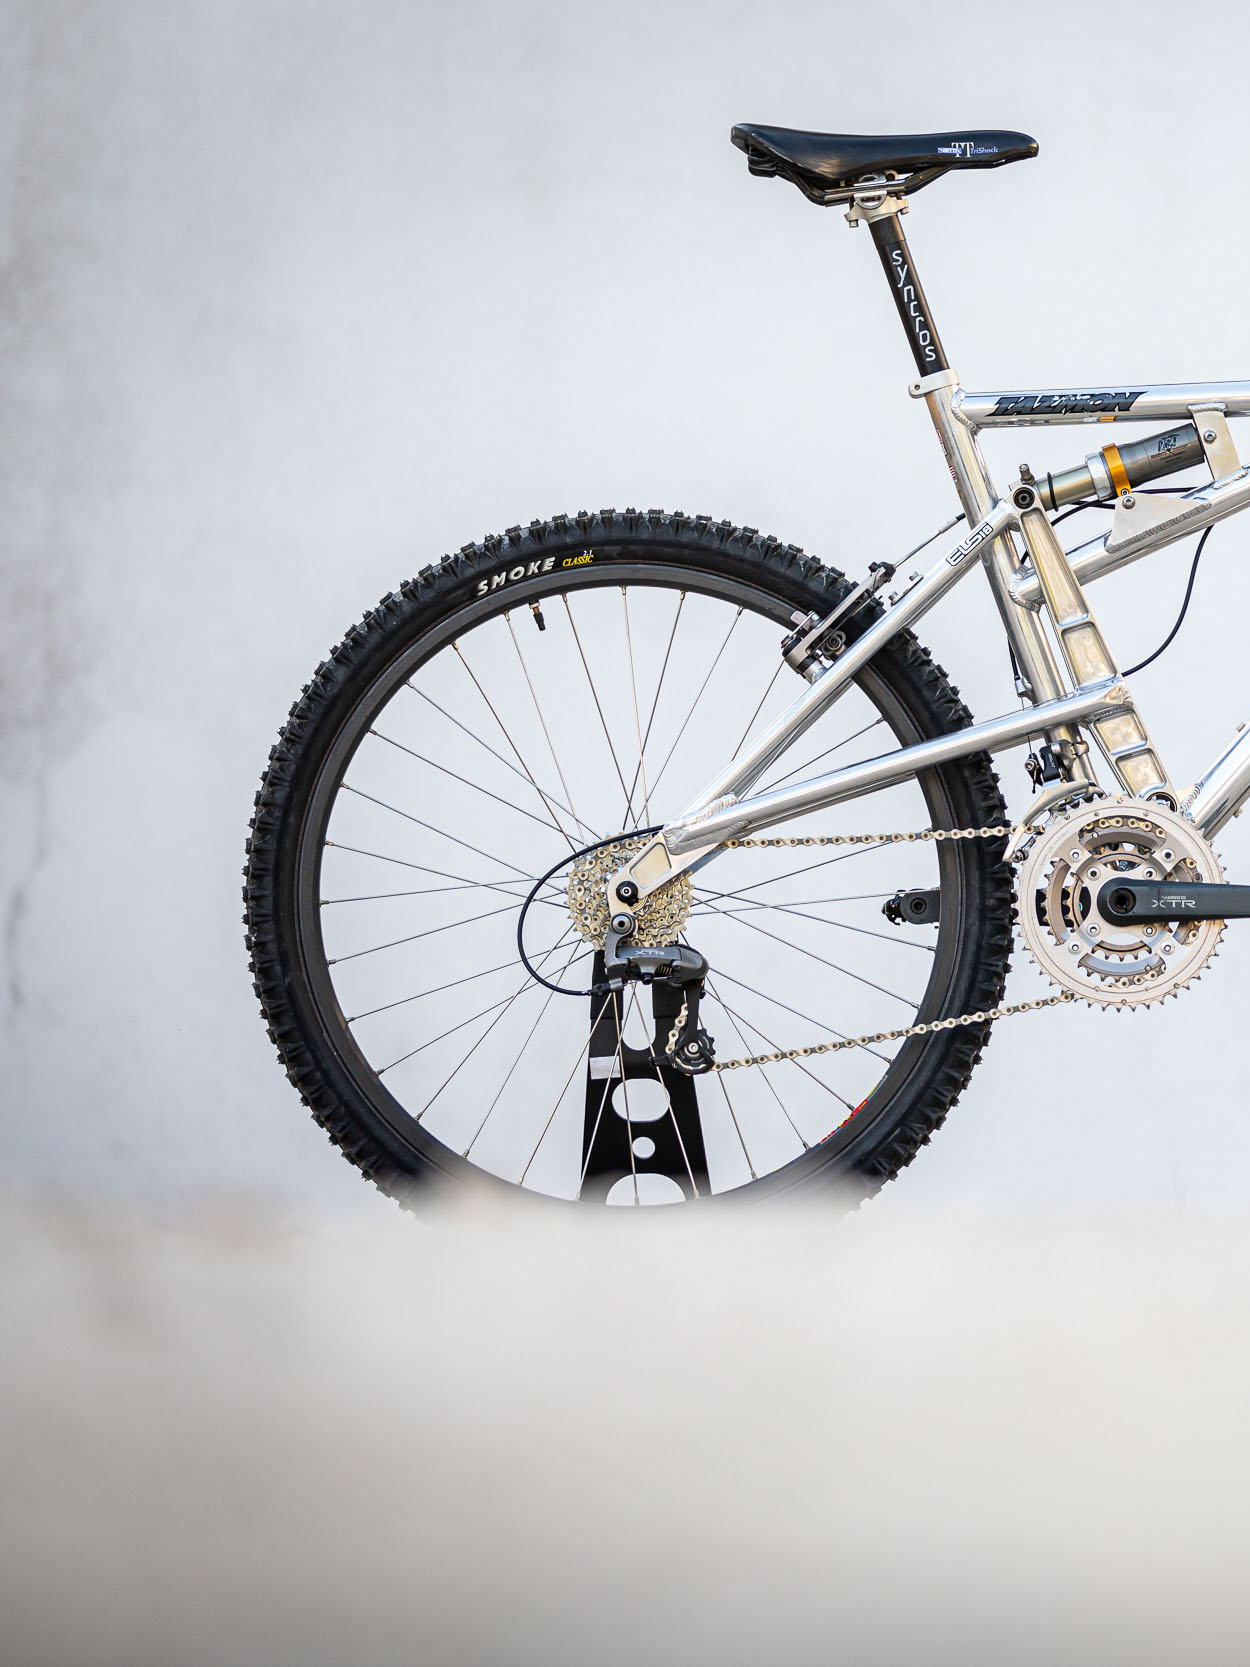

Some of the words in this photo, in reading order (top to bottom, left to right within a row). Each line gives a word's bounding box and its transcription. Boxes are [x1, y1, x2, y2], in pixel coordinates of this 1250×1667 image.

[892, 250, 936, 361] syncros
[984, 391, 1148, 417] TAZMON
[562, 555, 594, 567] CLASSIC
[477, 557, 556, 596] SMOKE
[1151, 899, 1197, 908] XTR
